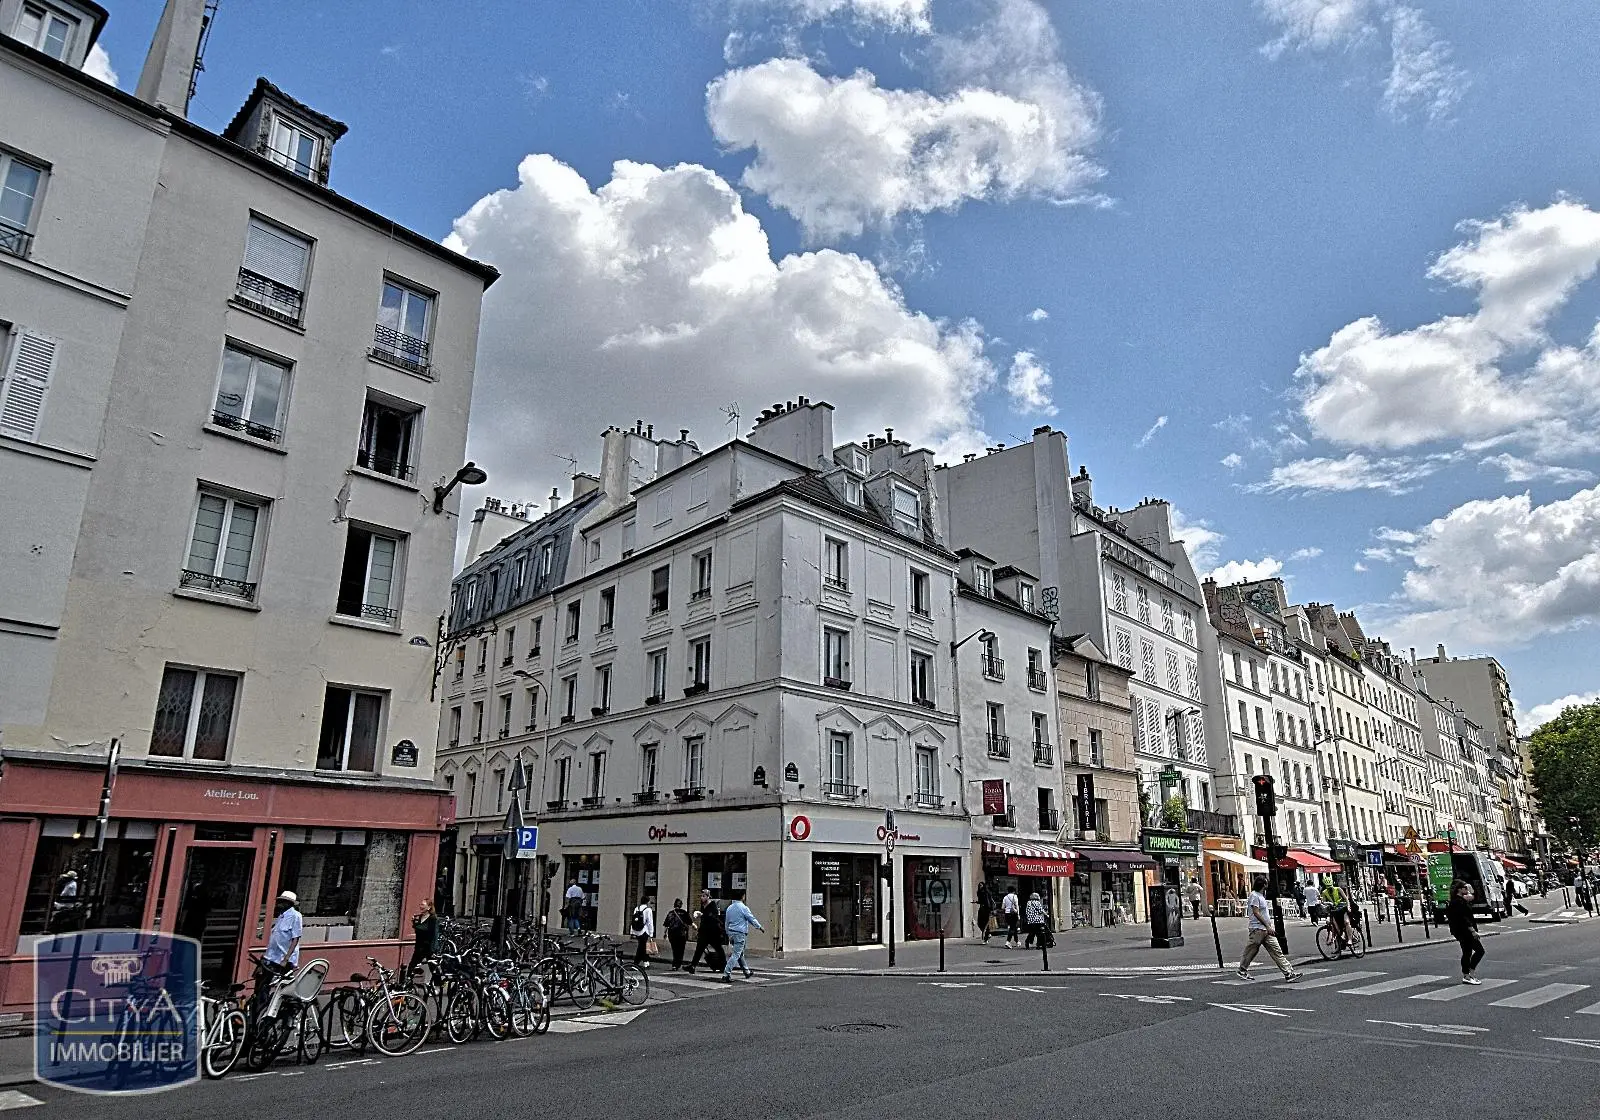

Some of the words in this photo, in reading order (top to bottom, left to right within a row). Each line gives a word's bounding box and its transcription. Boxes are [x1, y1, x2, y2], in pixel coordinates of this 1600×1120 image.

[204, 789, 237, 799] Atelier
[1082, 776, 1091, 829] LIBRAIRIE
[522, 831, 532, 846] P
[649, 824, 667, 842] Orpi
[1149, 836, 1181, 849] PHARMACIE
